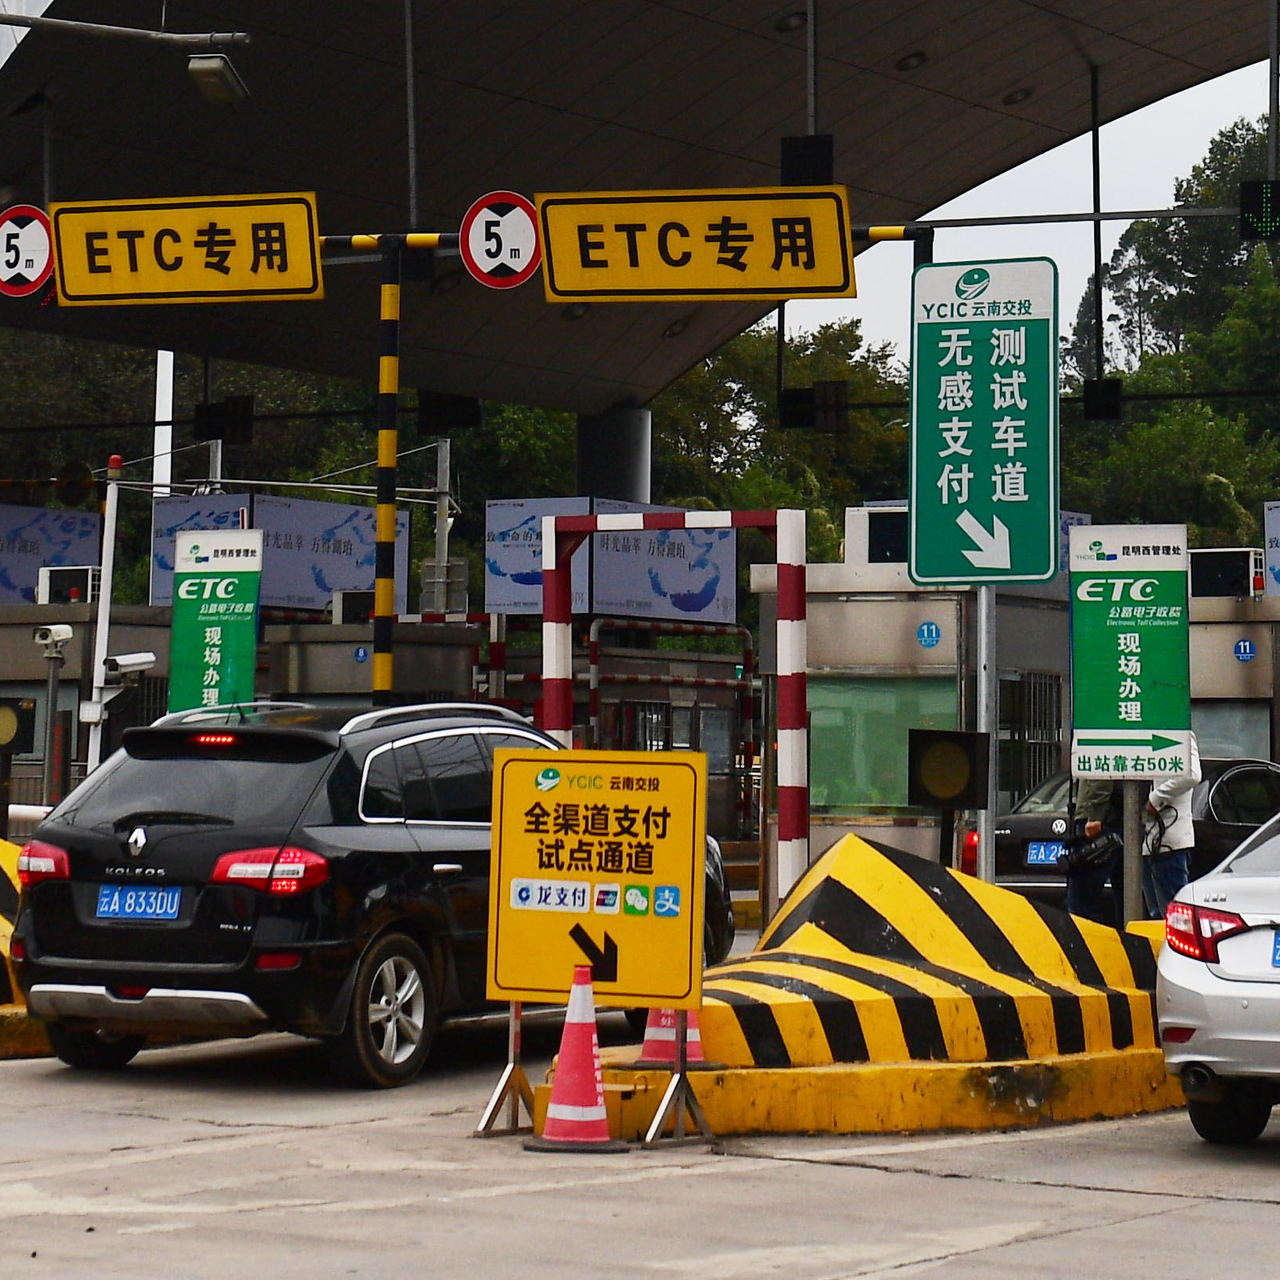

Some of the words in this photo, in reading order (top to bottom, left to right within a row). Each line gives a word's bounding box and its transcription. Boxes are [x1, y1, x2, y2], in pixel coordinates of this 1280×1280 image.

[85, 222, 288, 275] ETC专用
[484, 220, 502, 259] 5
[577, 216, 816, 272] ETC专用
[4, 233, 20, 269] 5
[922, 303, 968, 319] YCIC
[971, 300, 1032, 316] 云南交投
[937, 328, 974, 504] 无感支付
[990, 326, 1028, 502] 测试车道
[1122, 545, 1182, 556] 昆明西管理处
[178, 578, 238, 599] ETC
[1076, 579, 1160, 601] ETC
[1109, 606, 1182, 618] 公路电子收费
[922, 624, 936, 638] 11
[1238, 641, 1250, 653] 11
[202, 626, 223, 707] 现场办理
[1117, 633, 1142, 721] 现场办理
[1077, 755, 1184, 773] 出站靠右50米
[566, 775, 603, 790] YCIC
[609, 776, 660, 792] 云南交投
[524, 801, 671, 839] 全渠道支付
[537, 838, 654, 875] 试点通道
[105, 867, 166, 877] KOLEOS
[537, 885, 586, 907] 龙支付
